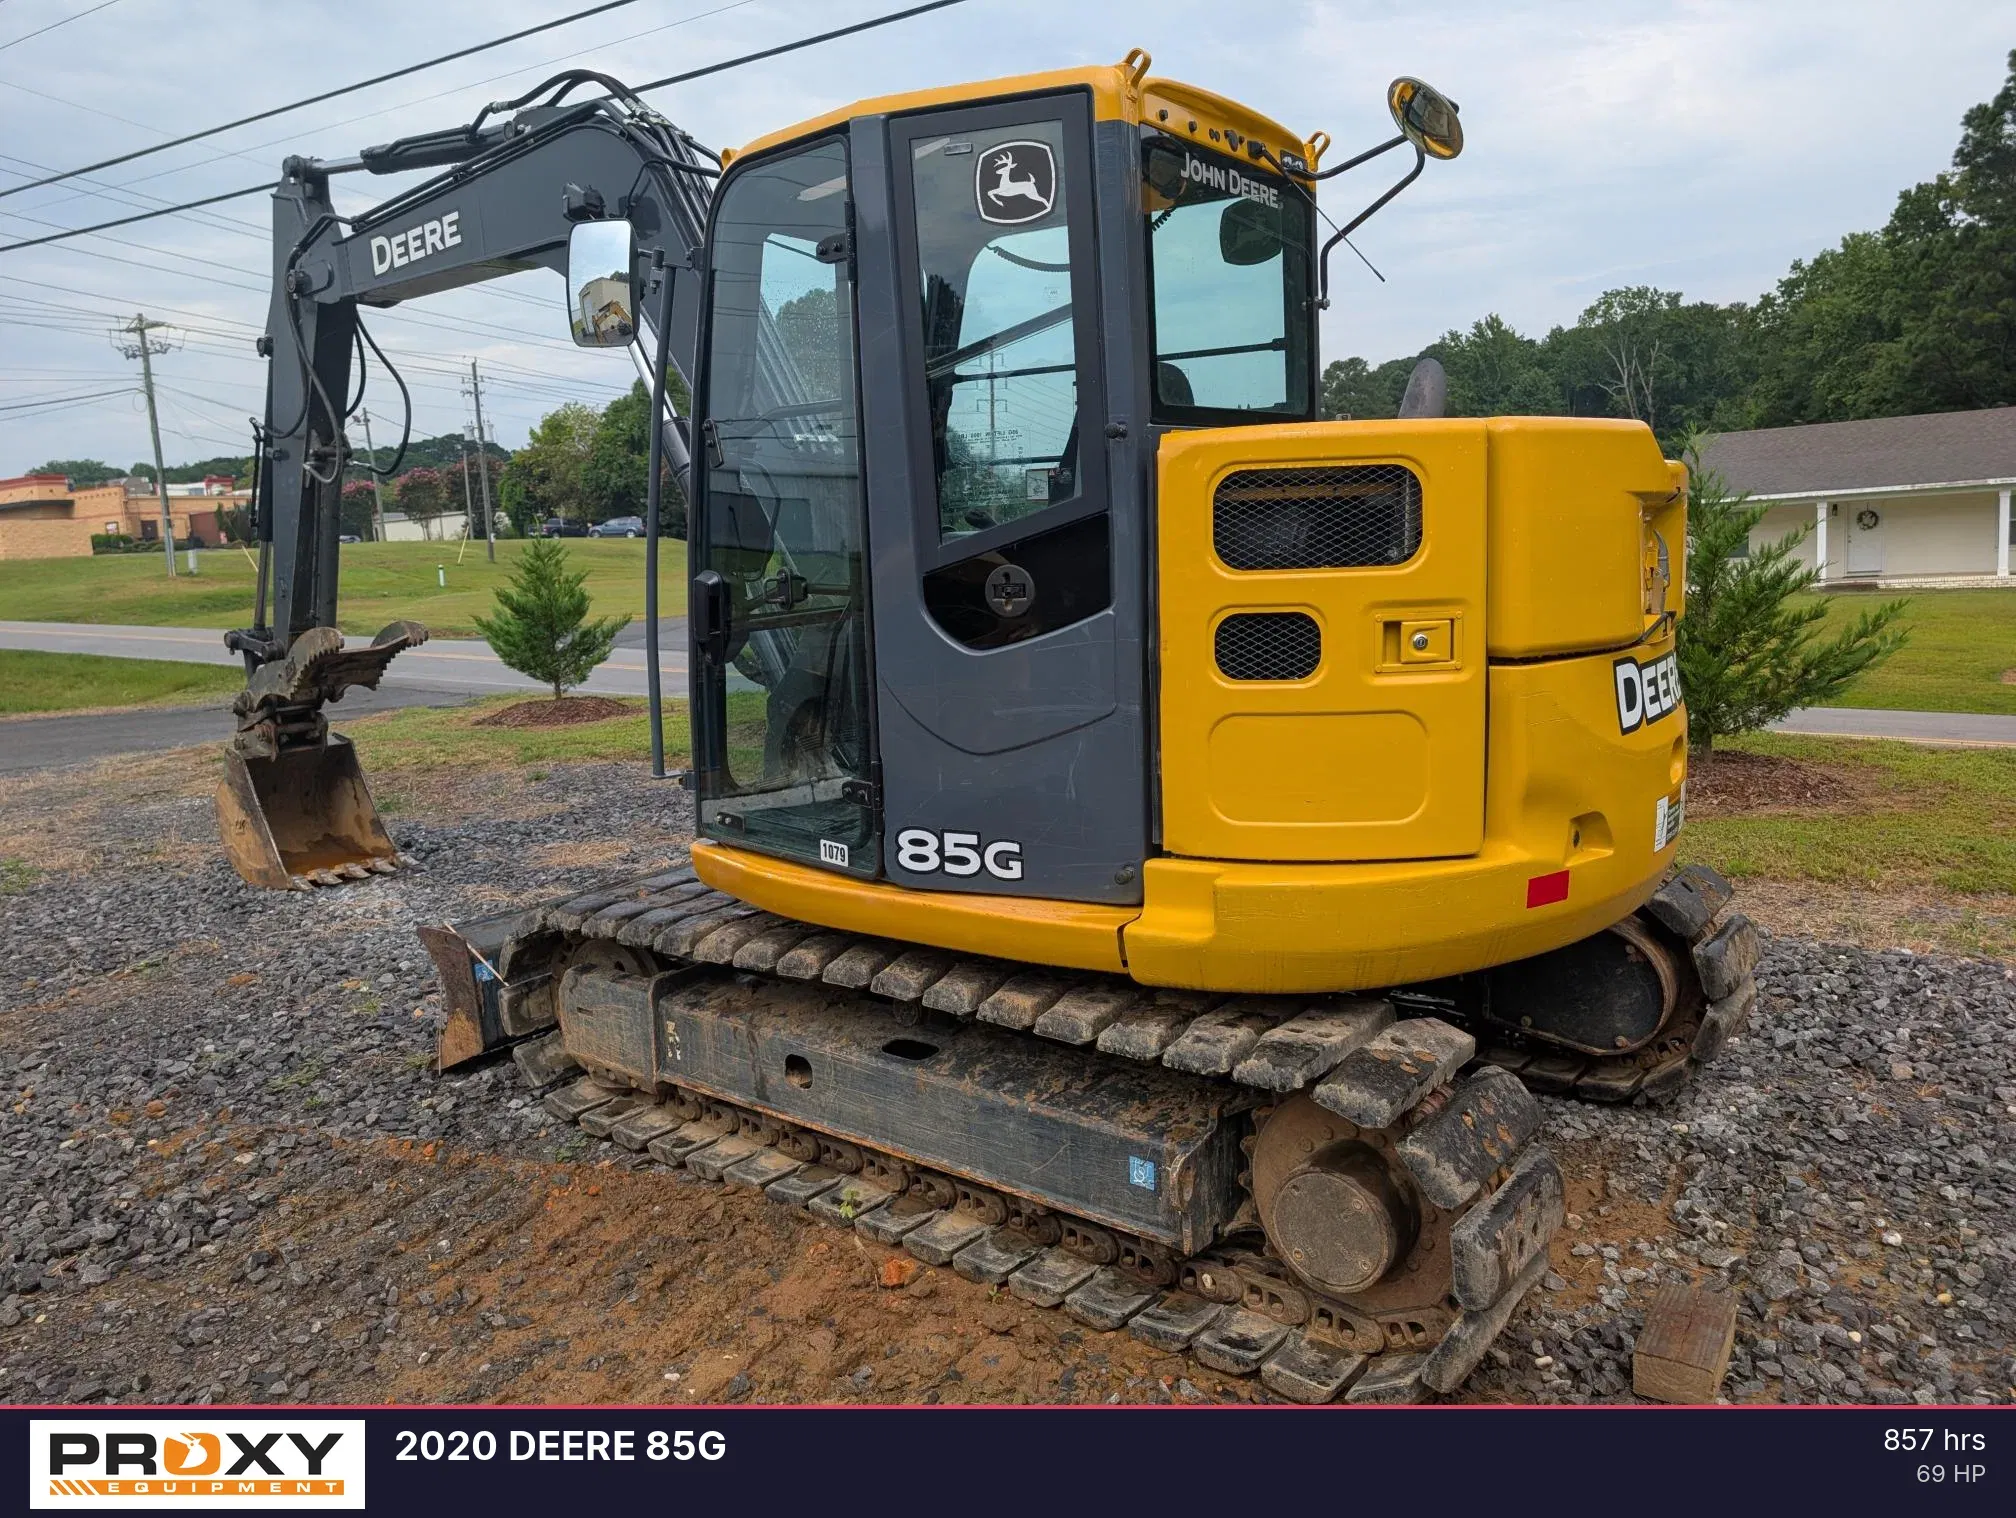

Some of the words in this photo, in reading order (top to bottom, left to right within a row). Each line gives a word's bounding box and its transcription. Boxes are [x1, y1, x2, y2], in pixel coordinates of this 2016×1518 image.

[1180, 151, 1226, 191] JOHN
[1229, 168, 1279, 209] DEERE
[370, 210, 462, 277] DEERE
[822, 842, 846, 863] 1079
[896, 828, 1024, 881] 85G
